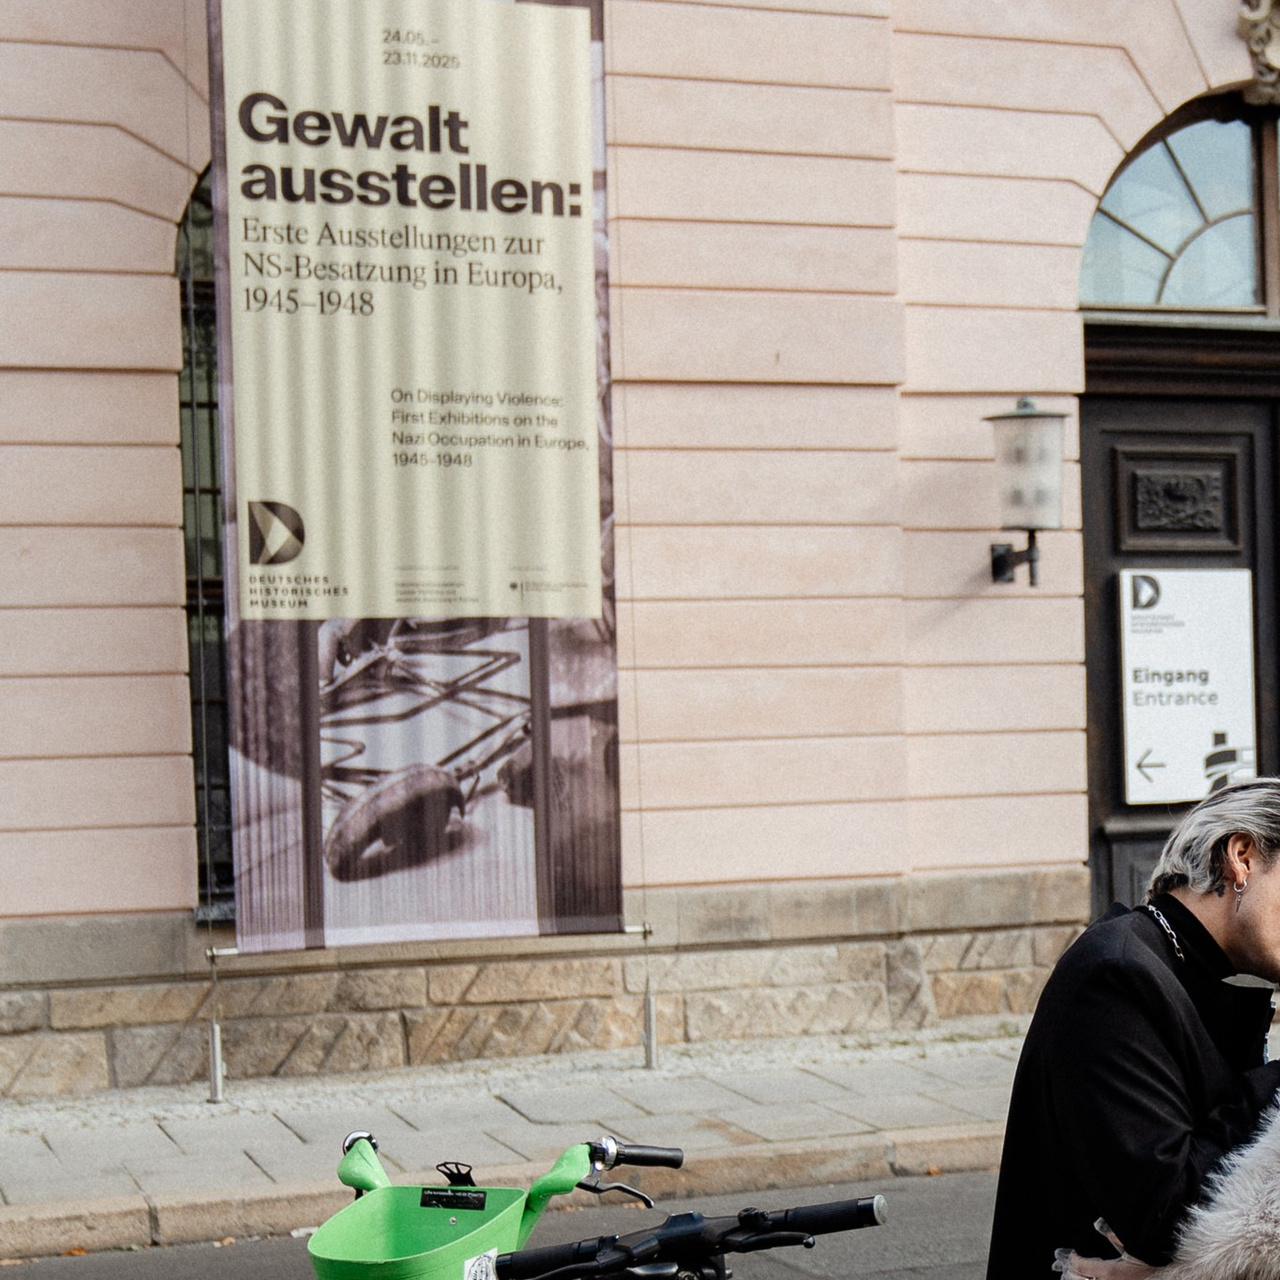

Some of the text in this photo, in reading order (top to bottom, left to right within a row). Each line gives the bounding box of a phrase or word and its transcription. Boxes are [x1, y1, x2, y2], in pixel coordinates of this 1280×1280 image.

[238, 92, 470, 154] Gewalt
[240, 162, 583, 218] ausstellen:
[242, 217, 546, 258] Erste Ausstellungen zur
[243, 252, 565, 295] NS-Besatzung in Europa,
[391, 388, 414, 404] On
[417, 389, 494, 407] Displaying
[391, 410, 558, 428] First Exhibitions on the
[392, 431, 425, 446] Nazi
[428, 432, 515, 450] Occupation
[518, 434, 532, 448] in
[249, 575, 329, 585] DEUTSCHES
[249, 586, 349, 597] HISTORISCHES
[250, 598, 308, 608] MUSEUM
[1132, 668, 1210, 686] Eingang
[1132, 690, 1219, 707] Entrance
